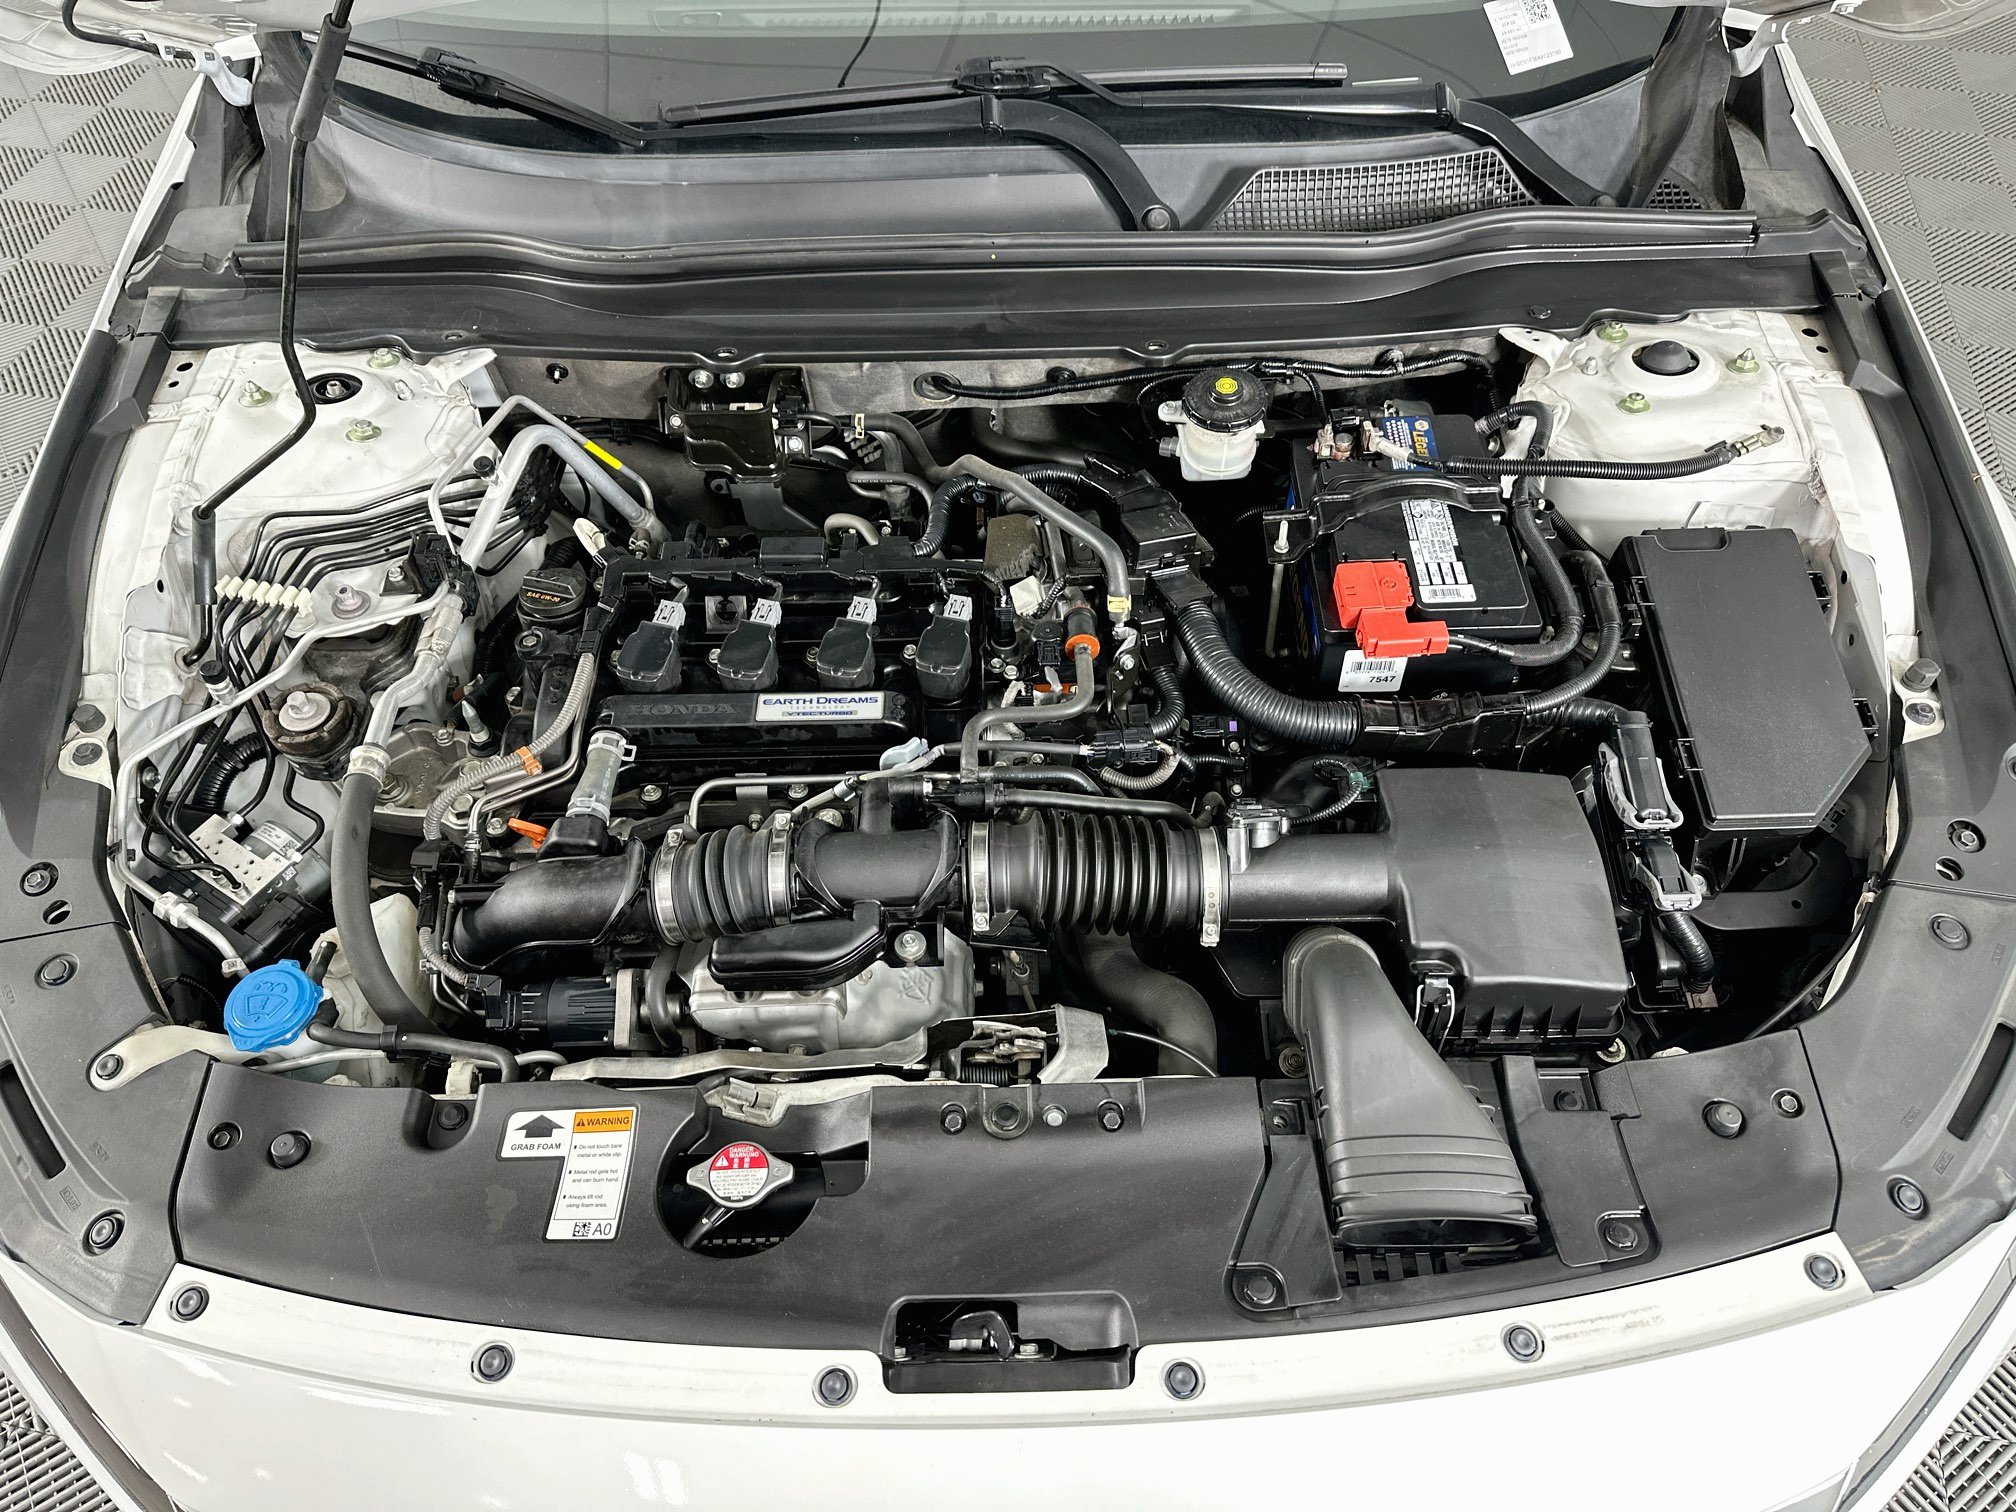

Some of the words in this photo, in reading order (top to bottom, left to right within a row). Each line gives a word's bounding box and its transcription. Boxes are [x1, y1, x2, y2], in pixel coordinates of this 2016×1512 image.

[1369, 675, 1396, 683] 7547
[762, 698, 813, 706] EARTH
[816, 696, 878, 705] DREAMS
[628, 703, 738, 715] HONDA
[587, 1116, 630, 1127] WARNING
[510, 1143, 535, 1151] GRAB
[536, 1142, 562, 1151] FOAM
[592, 1222, 612, 1236] A0
